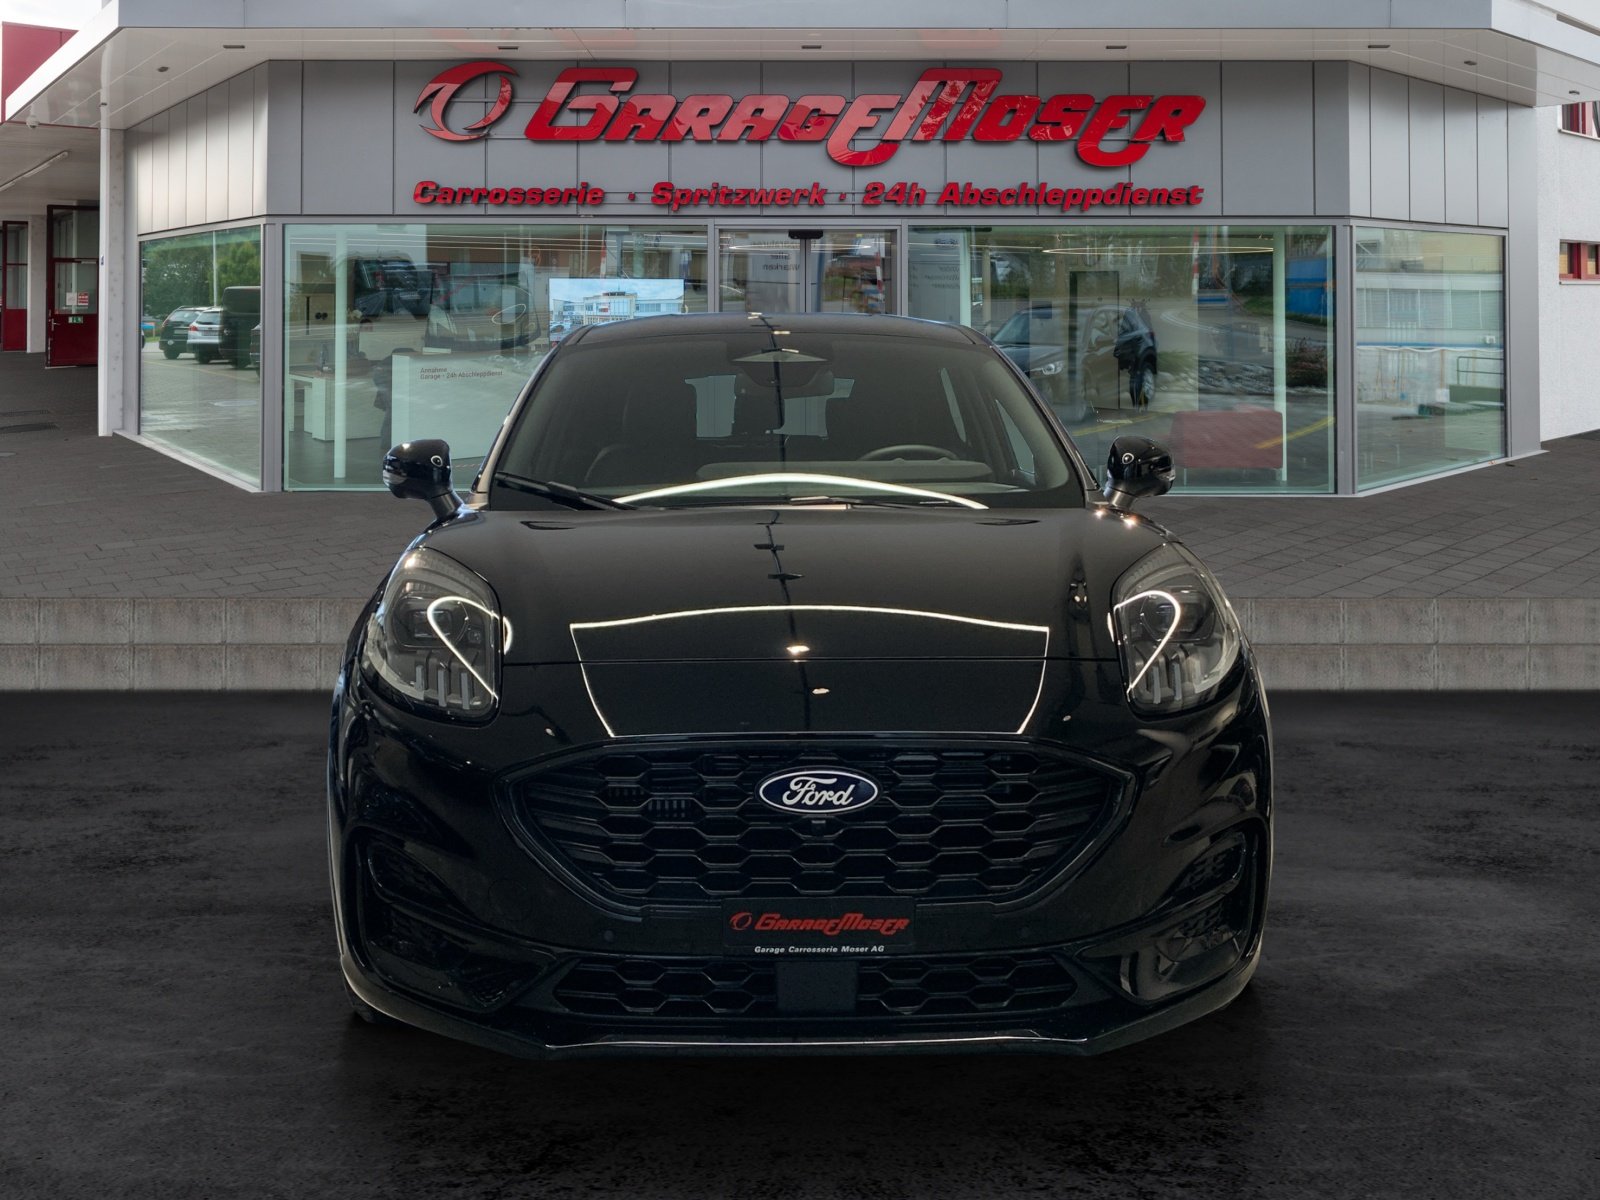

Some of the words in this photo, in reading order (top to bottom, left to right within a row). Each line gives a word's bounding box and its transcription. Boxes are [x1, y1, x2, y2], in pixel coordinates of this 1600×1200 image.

[413, 181, 605, 206] Carrosserie
[651, 182, 826, 211] Spritzwerk
[863, 182, 926, 206] 24h
[937, 182, 1204, 212] Abschleppdienst
[458, 370, 503, 378] Abschleppdienst
[782, 776, 856, 806] Ford
[754, 946, 785, 954] Garage
[788, 945, 838, 953] Carrosserie
[841, 945, 869, 953] Moser
